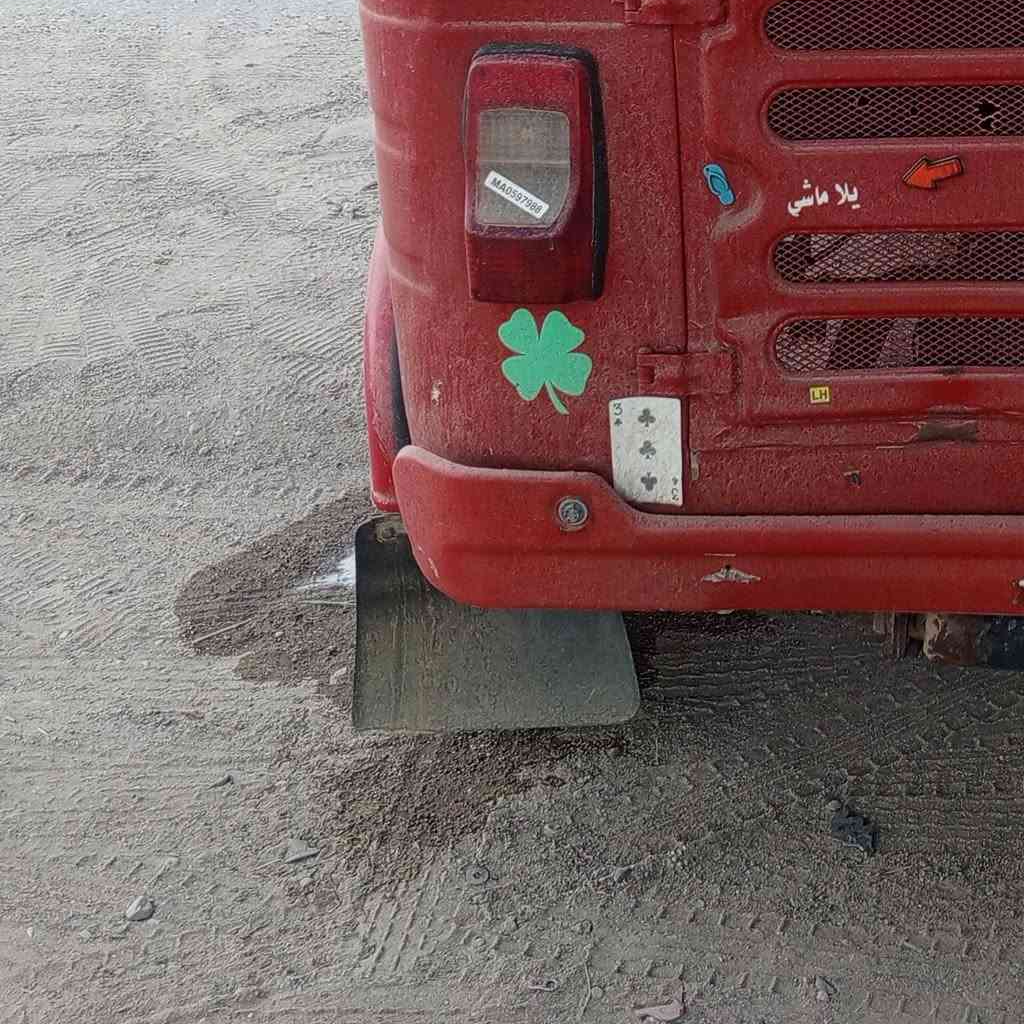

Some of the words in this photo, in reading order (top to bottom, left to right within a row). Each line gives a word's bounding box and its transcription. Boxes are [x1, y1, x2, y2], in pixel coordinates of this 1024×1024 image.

[490, 177, 544, 214] MA0597988
[834, 181, 861, 210] يلا
[812, 389, 828, 400] LH
[613, 403, 623, 416] 3
